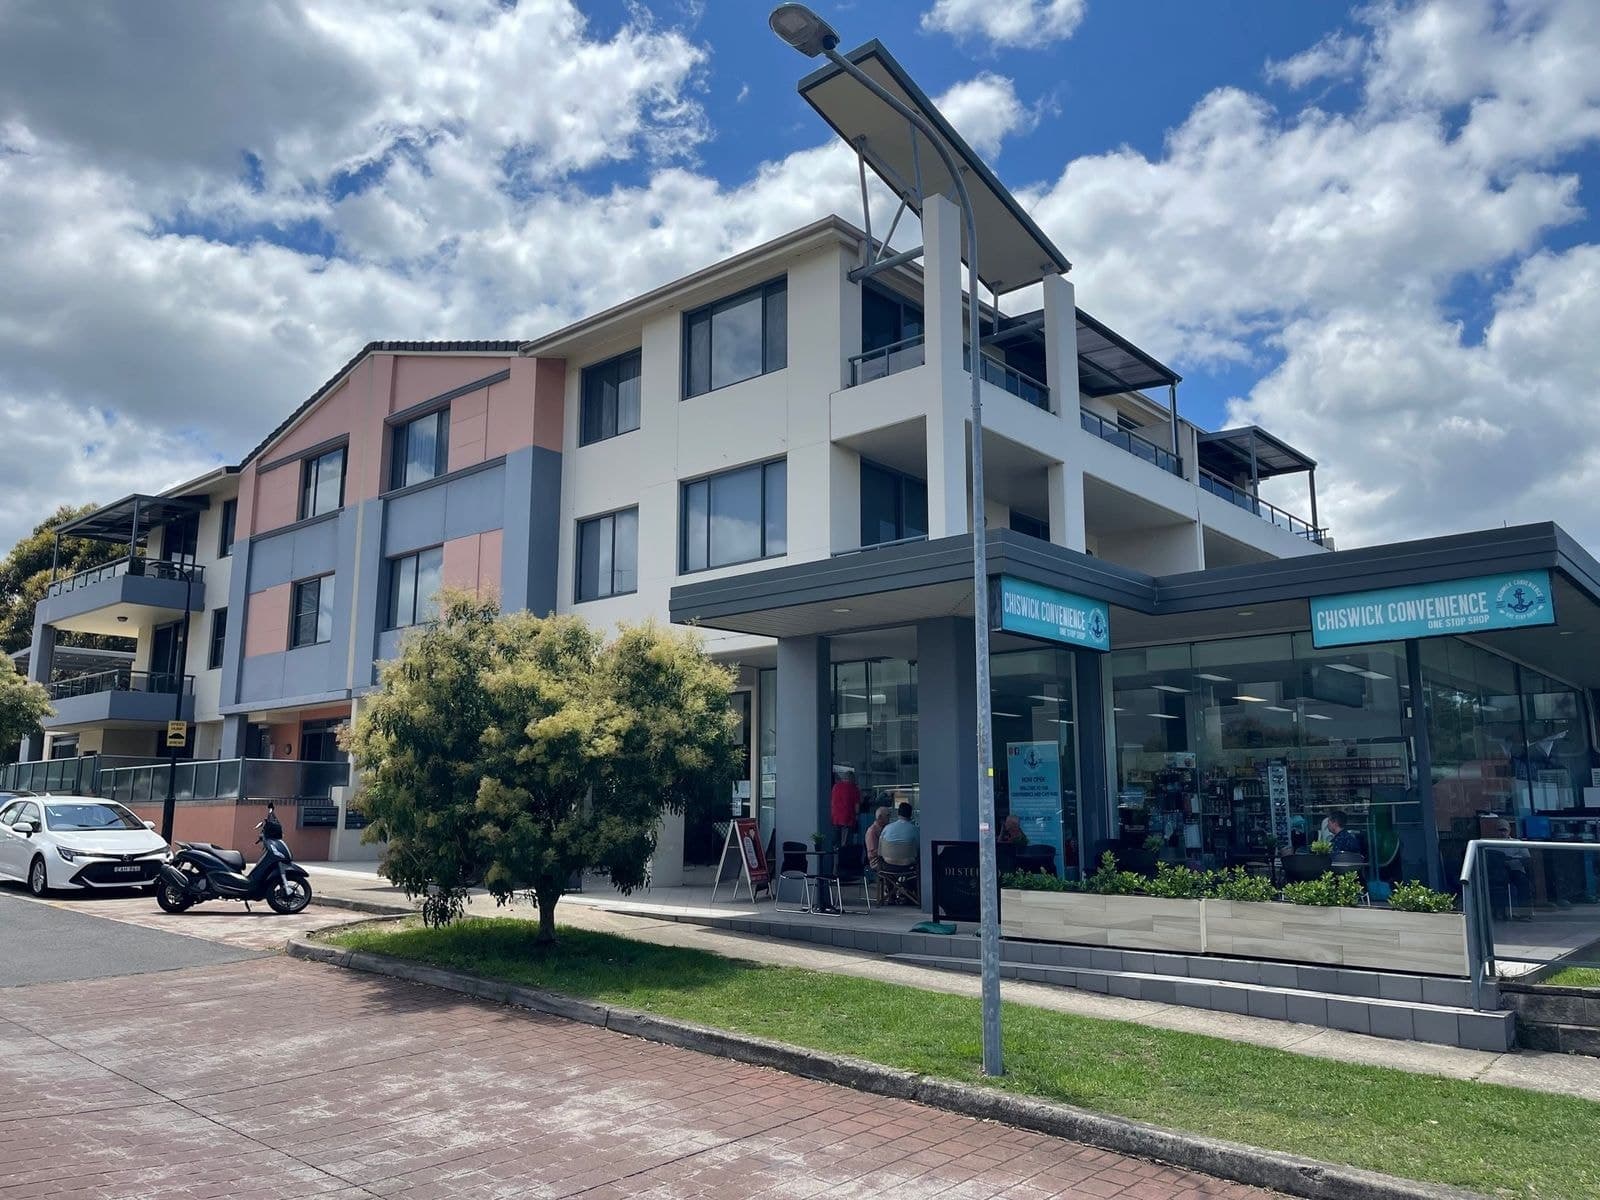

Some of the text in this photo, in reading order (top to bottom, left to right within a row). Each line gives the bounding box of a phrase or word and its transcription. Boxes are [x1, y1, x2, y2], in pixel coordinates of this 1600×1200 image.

[1004, 592, 1040, 619] CHISWICK
[1041, 602, 1086, 631] CONVENIENCE
[1317, 592, 1489, 631] CHISWICK CONVENIENCE
[1428, 614, 1490, 629] ONE STOP SHOP
